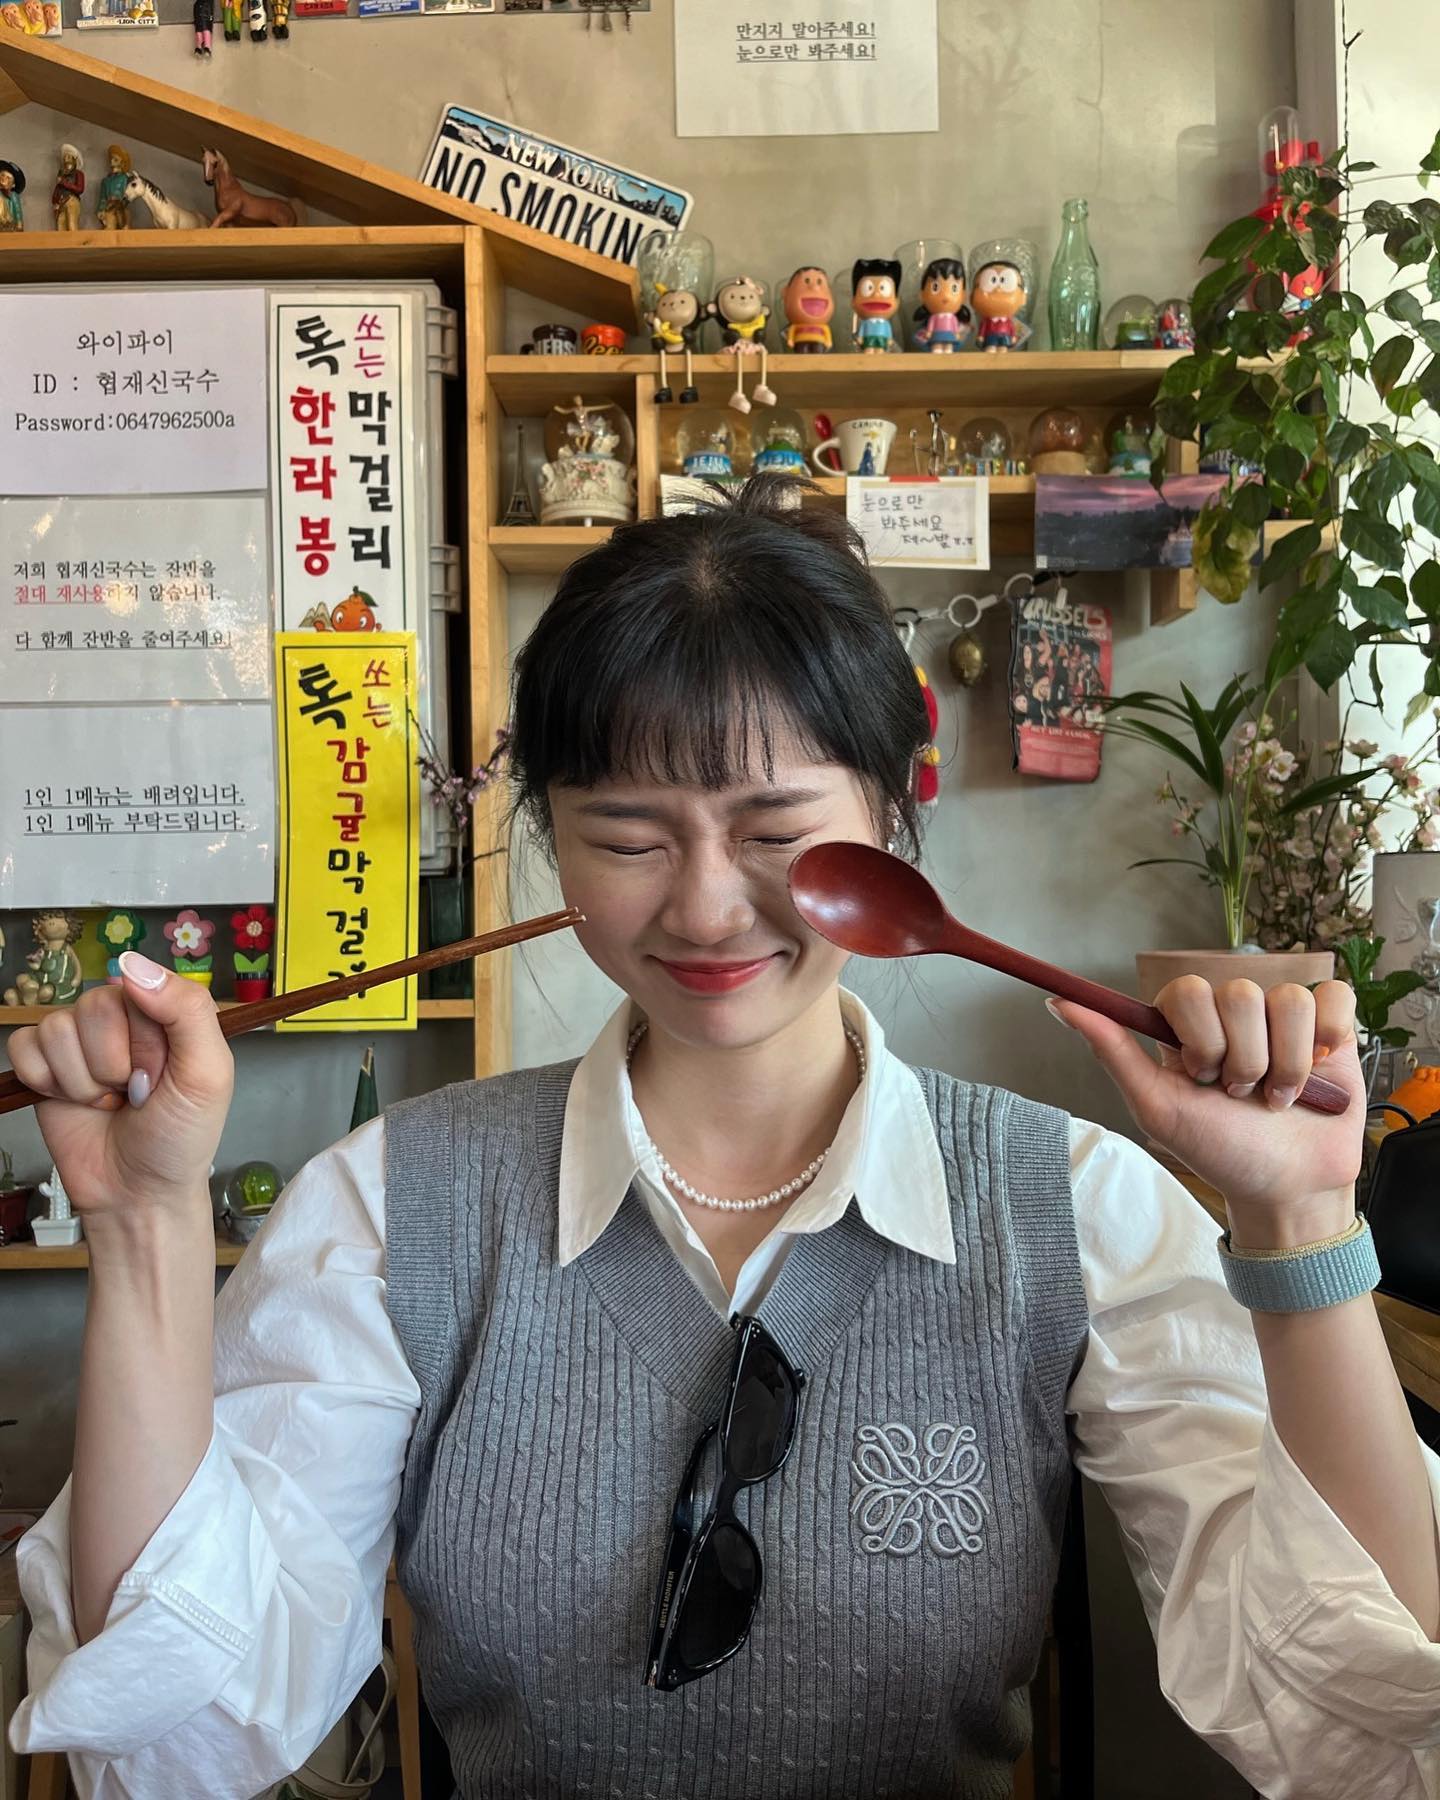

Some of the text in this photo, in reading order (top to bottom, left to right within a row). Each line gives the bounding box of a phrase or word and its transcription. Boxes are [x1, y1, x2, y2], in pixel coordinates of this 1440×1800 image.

[736, 21, 876, 39] 만지지 말아주세요!
[736, 43, 876, 61] 눈으로만 봐주세요!
[432, 146, 487, 203] NO
[500, 133, 624, 201] NEW YORK
[77, 329, 172, 356] 와이파이
[295, 313, 385, 378] 톡 쏘는
[33, 374, 57, 394] ID
[96, 369, 220, 395] 협재신국수
[15, 411, 235, 432] Password:0647962500a
[289, 386, 393, 577] 한라봉 막걸리
[862, 492, 923, 512] 눈으로만
[881, 515, 943, 531] 봐주세요
[13, 560, 216, 580] 저희 협재신국수는 잔반을
[15, 584, 46, 603] 절대
[16, 631, 32, 649] 다
[41, 631, 73, 649] 함께
[82, 630, 133, 649] 잔반을
[298, 659, 391, 729] 톡 쏘는
[25, 784, 245, 807] 1인 1메뉴는 배려입니다.
[26, 810, 245, 833] 1인 1메뉴 부탁드립니다.
